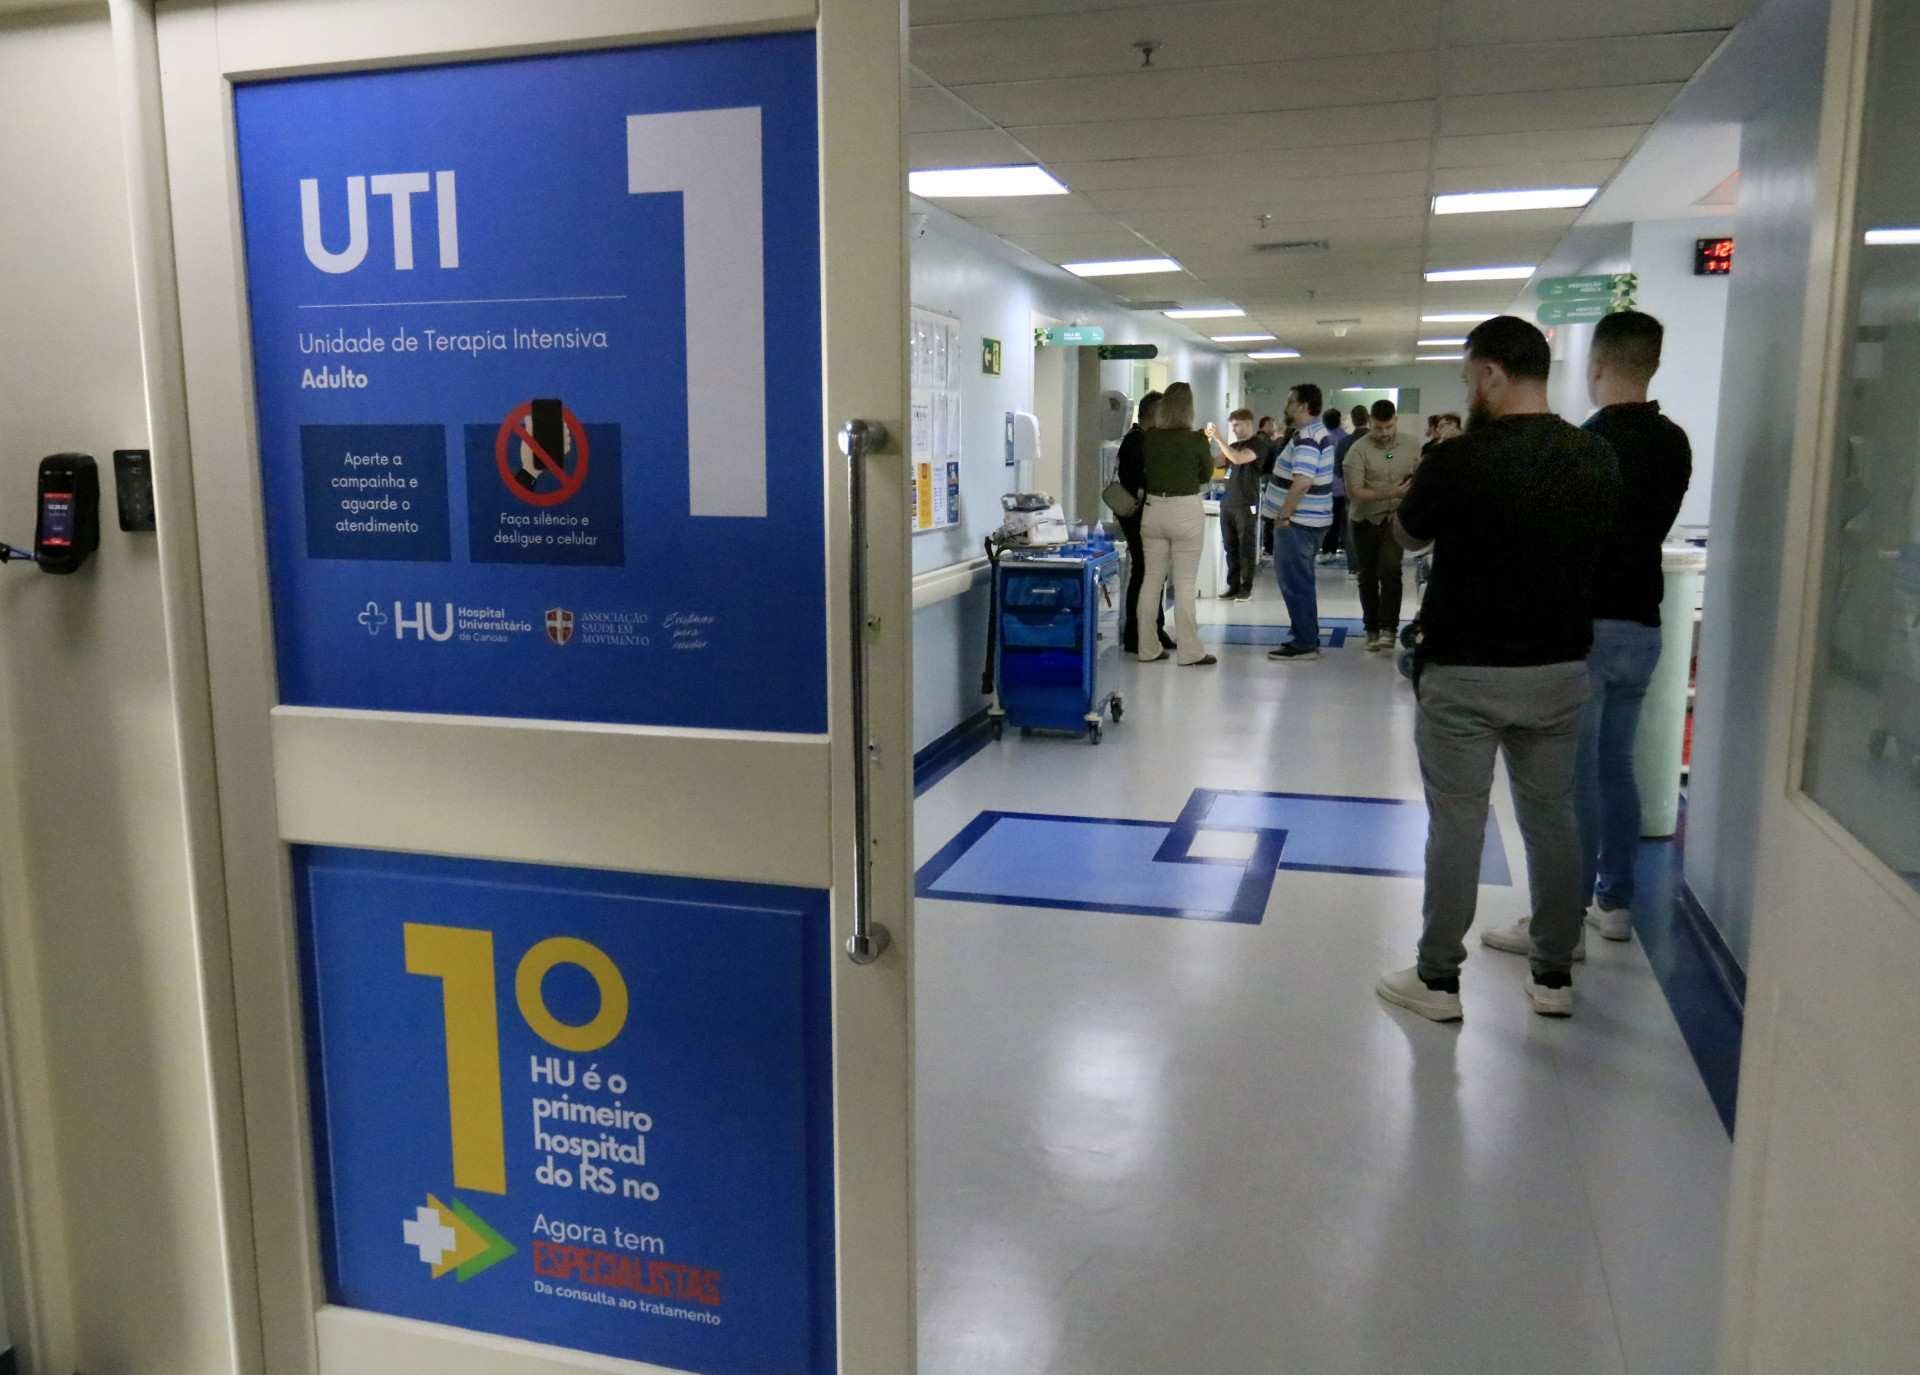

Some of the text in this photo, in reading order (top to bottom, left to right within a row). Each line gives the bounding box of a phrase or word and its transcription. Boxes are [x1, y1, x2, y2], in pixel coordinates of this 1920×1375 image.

[300, 170, 460, 273] UTI
[627, 106, 767, 518] 1
[299, 327, 609, 358] Unidade de Terapia Intensiva
[301, 365, 369, 390] Adulto
[343, 452, 403, 470] Aperte a
[331, 472, 418, 492] campainha e
[341, 494, 411, 514] aguarde o
[335, 516, 419, 533] atendimento
[500, 510, 590, 527] Faça silêncio e
[494, 529, 598, 548] desligue o celular
[394, 600, 454, 642] HU
[457, 606, 506, 620] Hospital
[458, 618, 533, 632] Universitário
[581, 633, 650, 647] MOVIMENTO
[617, 624, 634, 635] EM
[530, 1055, 628, 1094] HU é o
[532, 1094, 653, 1133] primeiro
[534, 1122, 646, 1166] hospital
[535, 1155, 660, 1202] do RS no
[532, 1213, 665, 1255] Agora tem
[532, 1240, 722, 1307] ESPECIALISTAS
[533, 1280, 721, 1326] Da consulta ao tratamento
